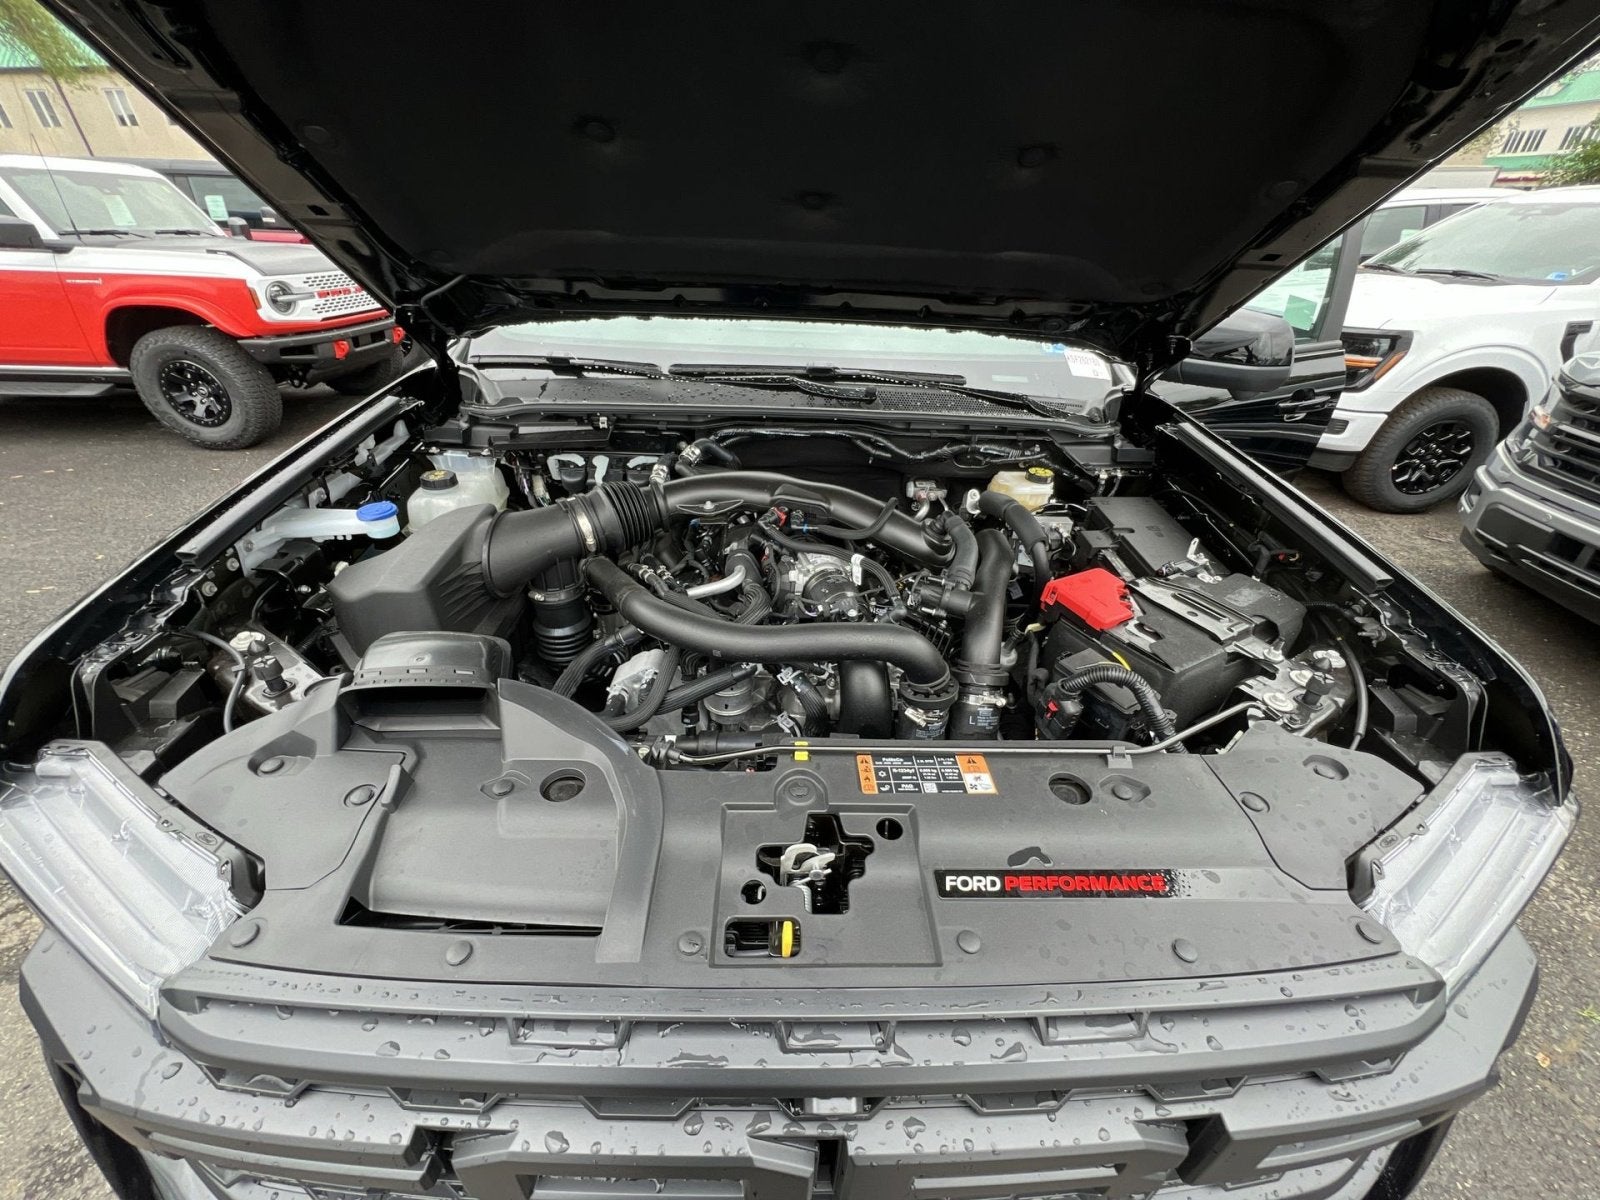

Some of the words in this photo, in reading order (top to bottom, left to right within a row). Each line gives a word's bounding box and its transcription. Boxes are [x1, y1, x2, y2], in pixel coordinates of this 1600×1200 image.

[969, 715, 976, 725] L
[945, 875, 1001, 892] FORD
[1004, 875, 1169, 892] PERFORMANCE
